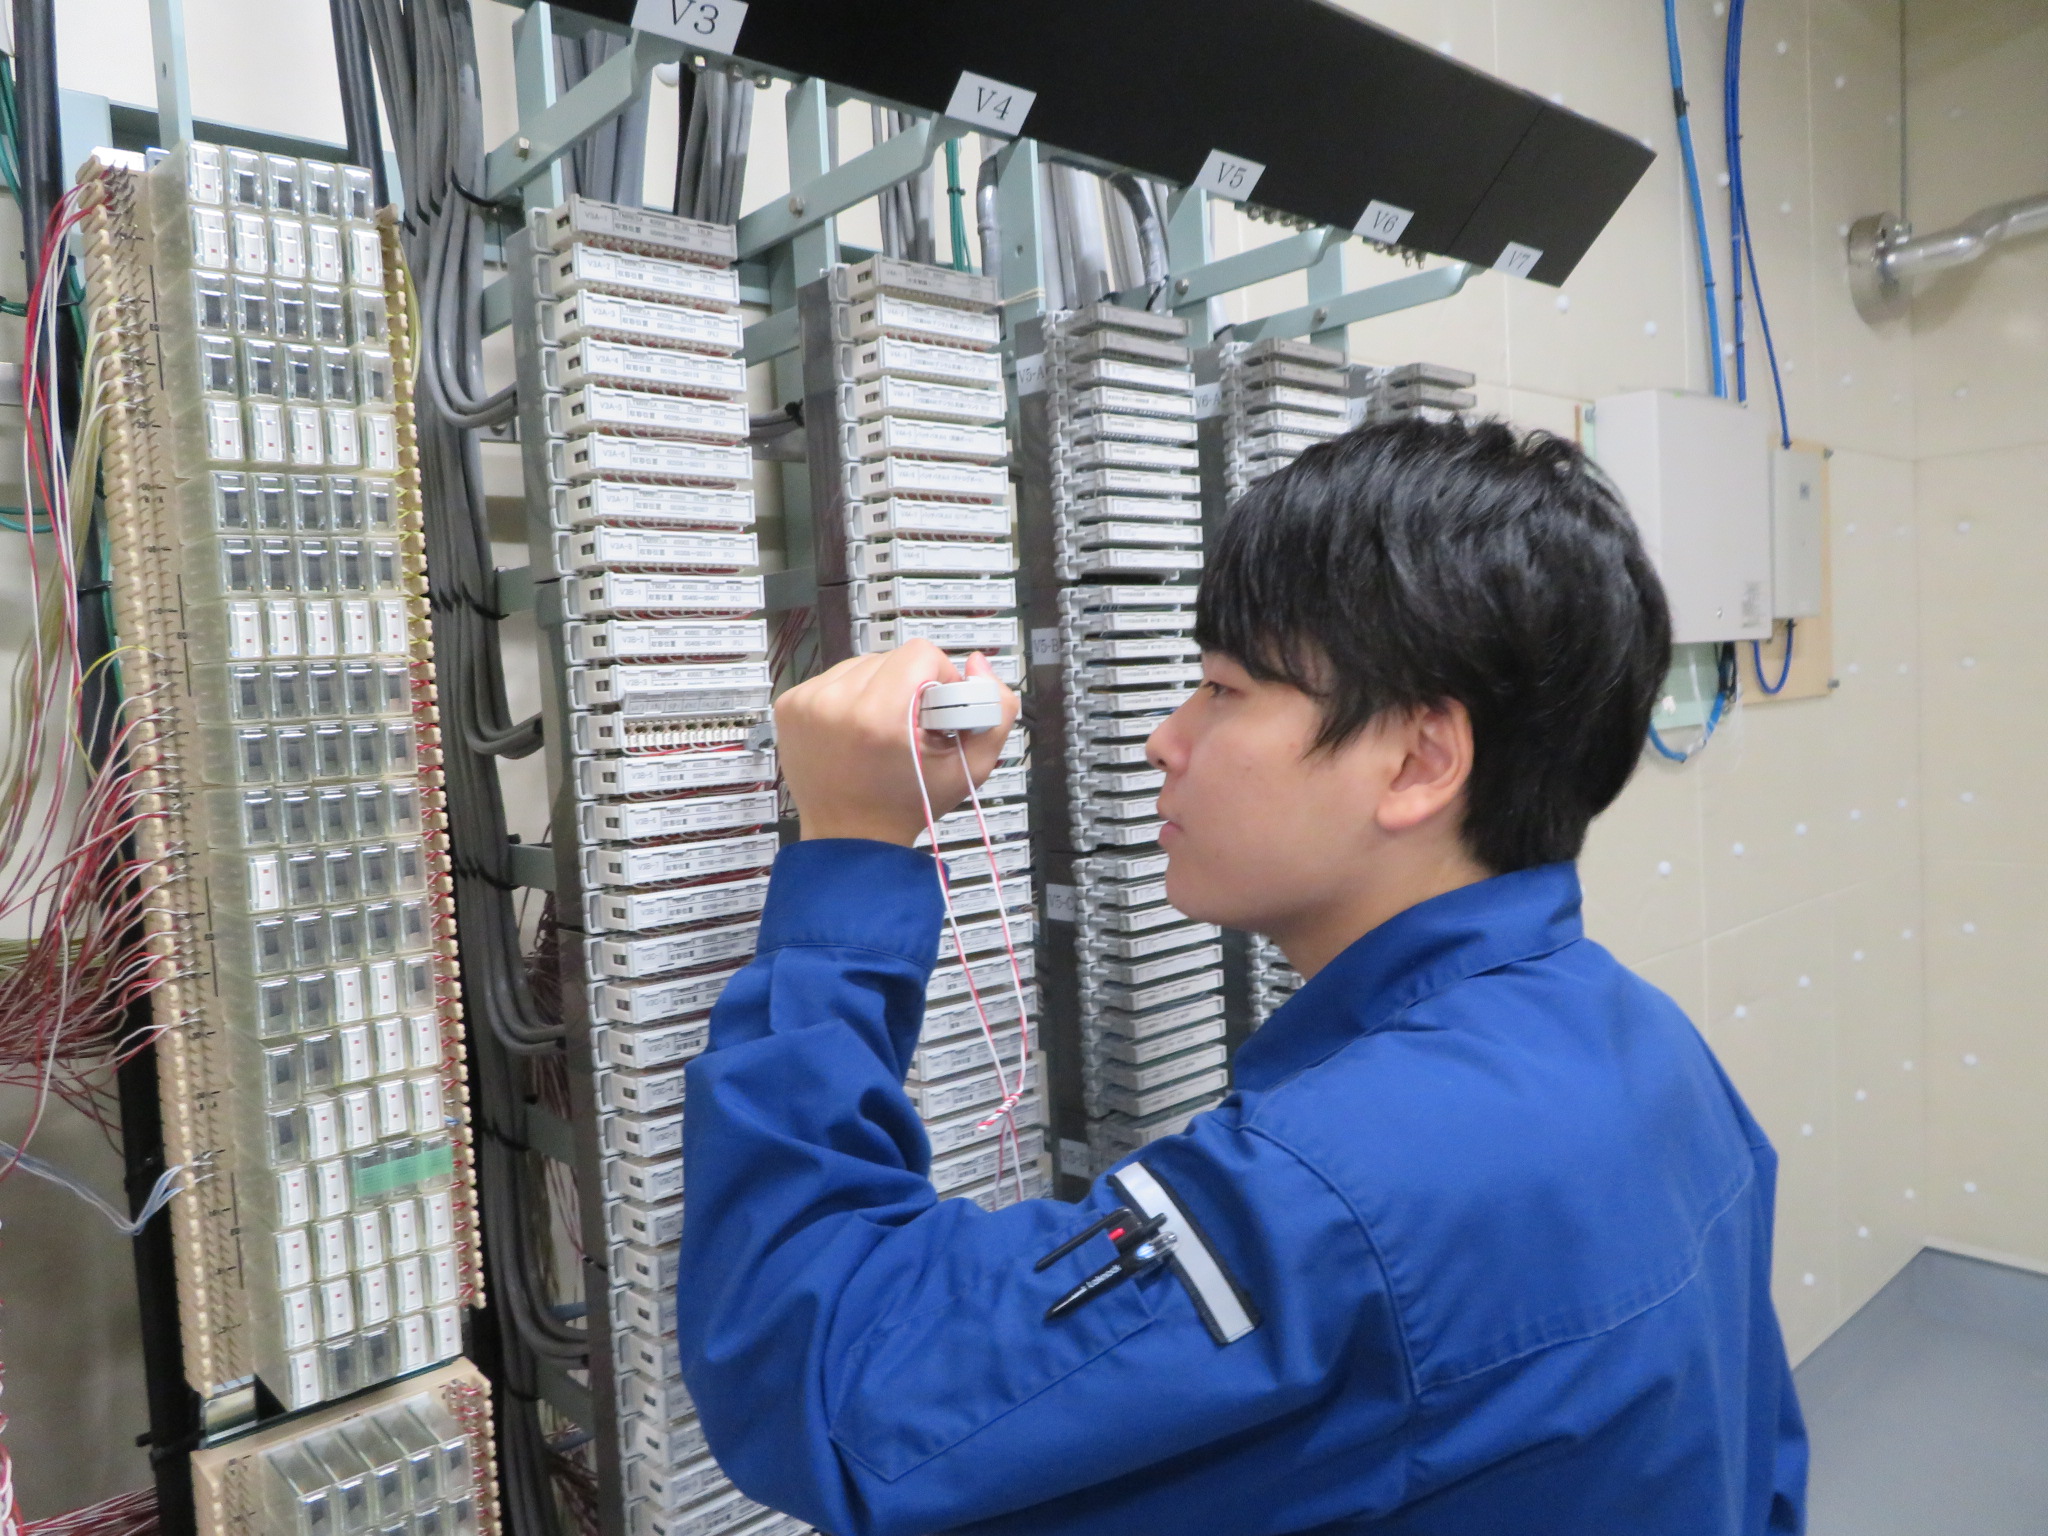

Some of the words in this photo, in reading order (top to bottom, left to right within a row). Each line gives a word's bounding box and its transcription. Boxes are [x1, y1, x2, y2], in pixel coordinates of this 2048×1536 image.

[670, 0, 719, 35] V3
[977, 86, 1013, 121] V4
[1217, 161, 1247, 189] V5
[1373, 210, 1399, 234] V6
[1508, 250, 1531, 270] V7
[1018, 364, 1045, 384] V5-A
[1033, 639, 1060, 653] V5-B
[1048, 894, 1075, 911] V5-C
